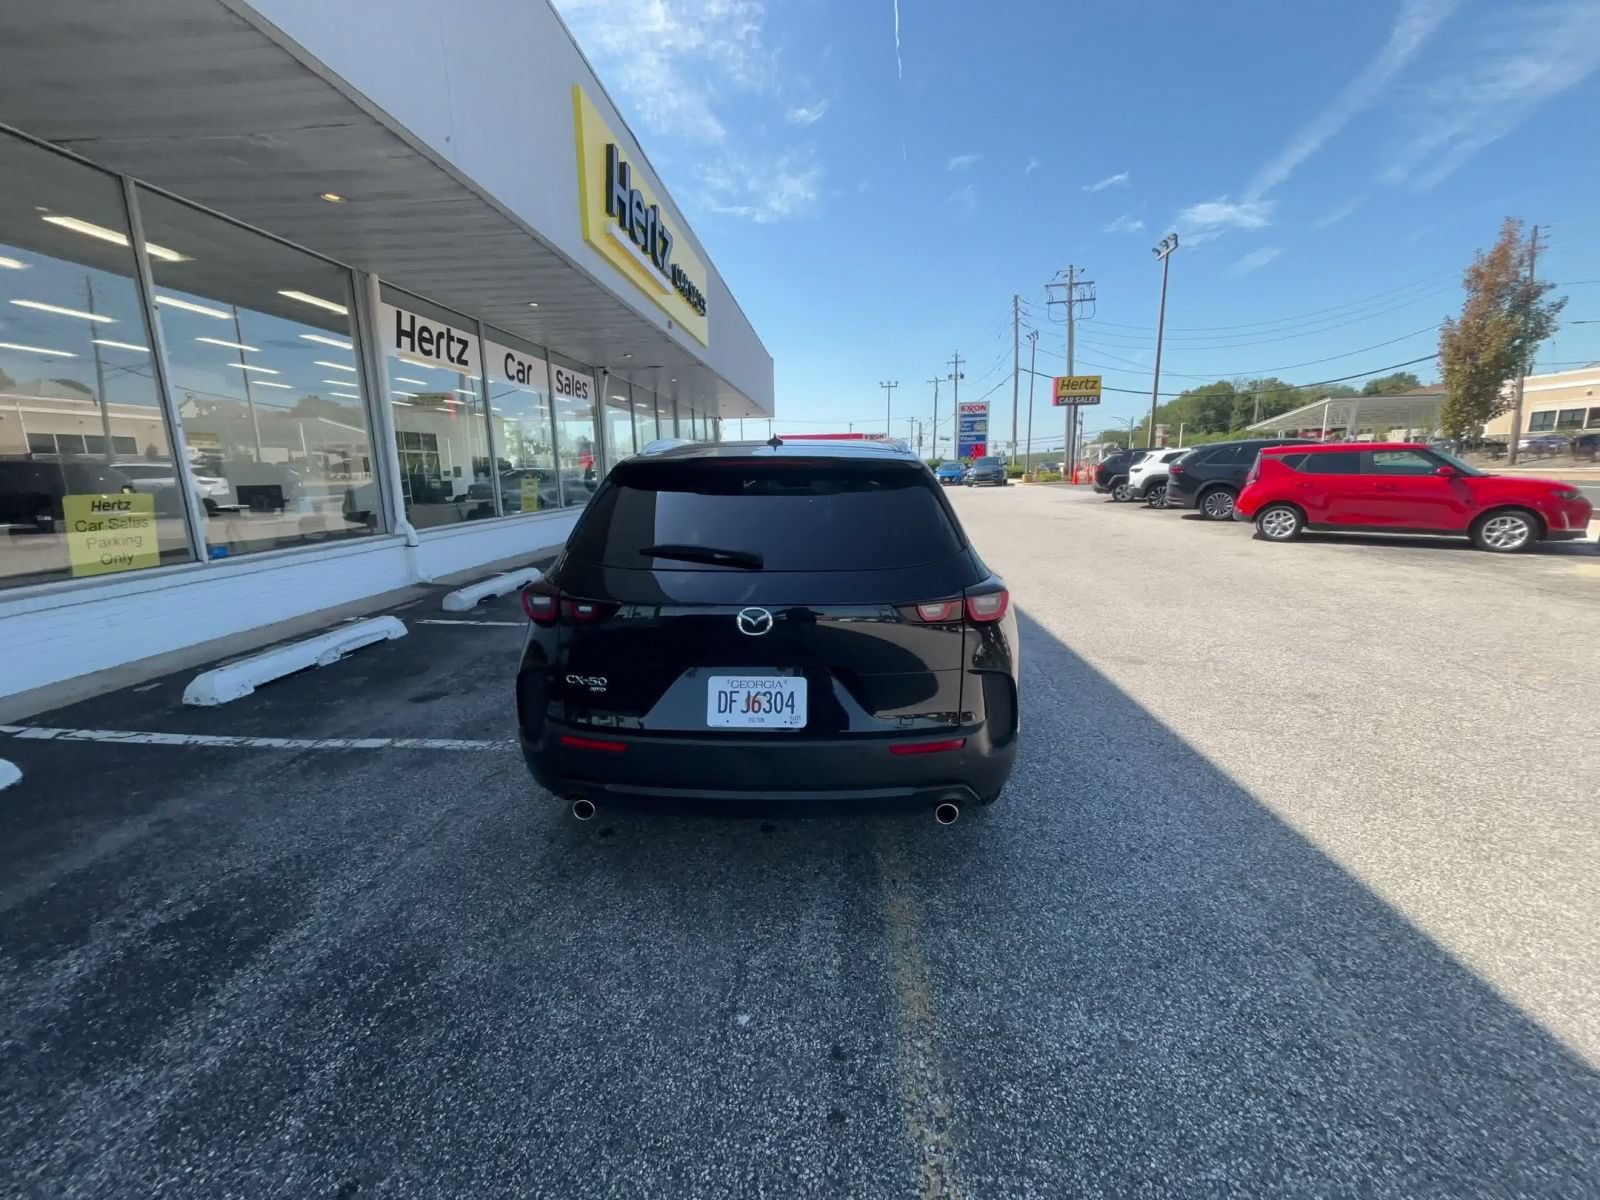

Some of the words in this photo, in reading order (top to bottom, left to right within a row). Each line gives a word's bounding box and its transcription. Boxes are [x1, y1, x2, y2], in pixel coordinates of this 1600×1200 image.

[606, 143, 673, 279] Hertz
[395, 310, 469, 366] Hertz
[504, 353, 532, 385] Car
[555, 370, 588, 399] Sales
[1061, 378, 1098, 390] Hertz
[961, 404, 987, 413] EXXON
[91, 500, 132, 512] Hertz
[74, 520, 104, 532] Car
[108, 517, 149, 530] Sales
[86, 535, 143, 550] Parking
[101, 553, 134, 565] Only
[566, 675, 607, 686] CX-50
[731, 680, 783, 689] GEORGIA
